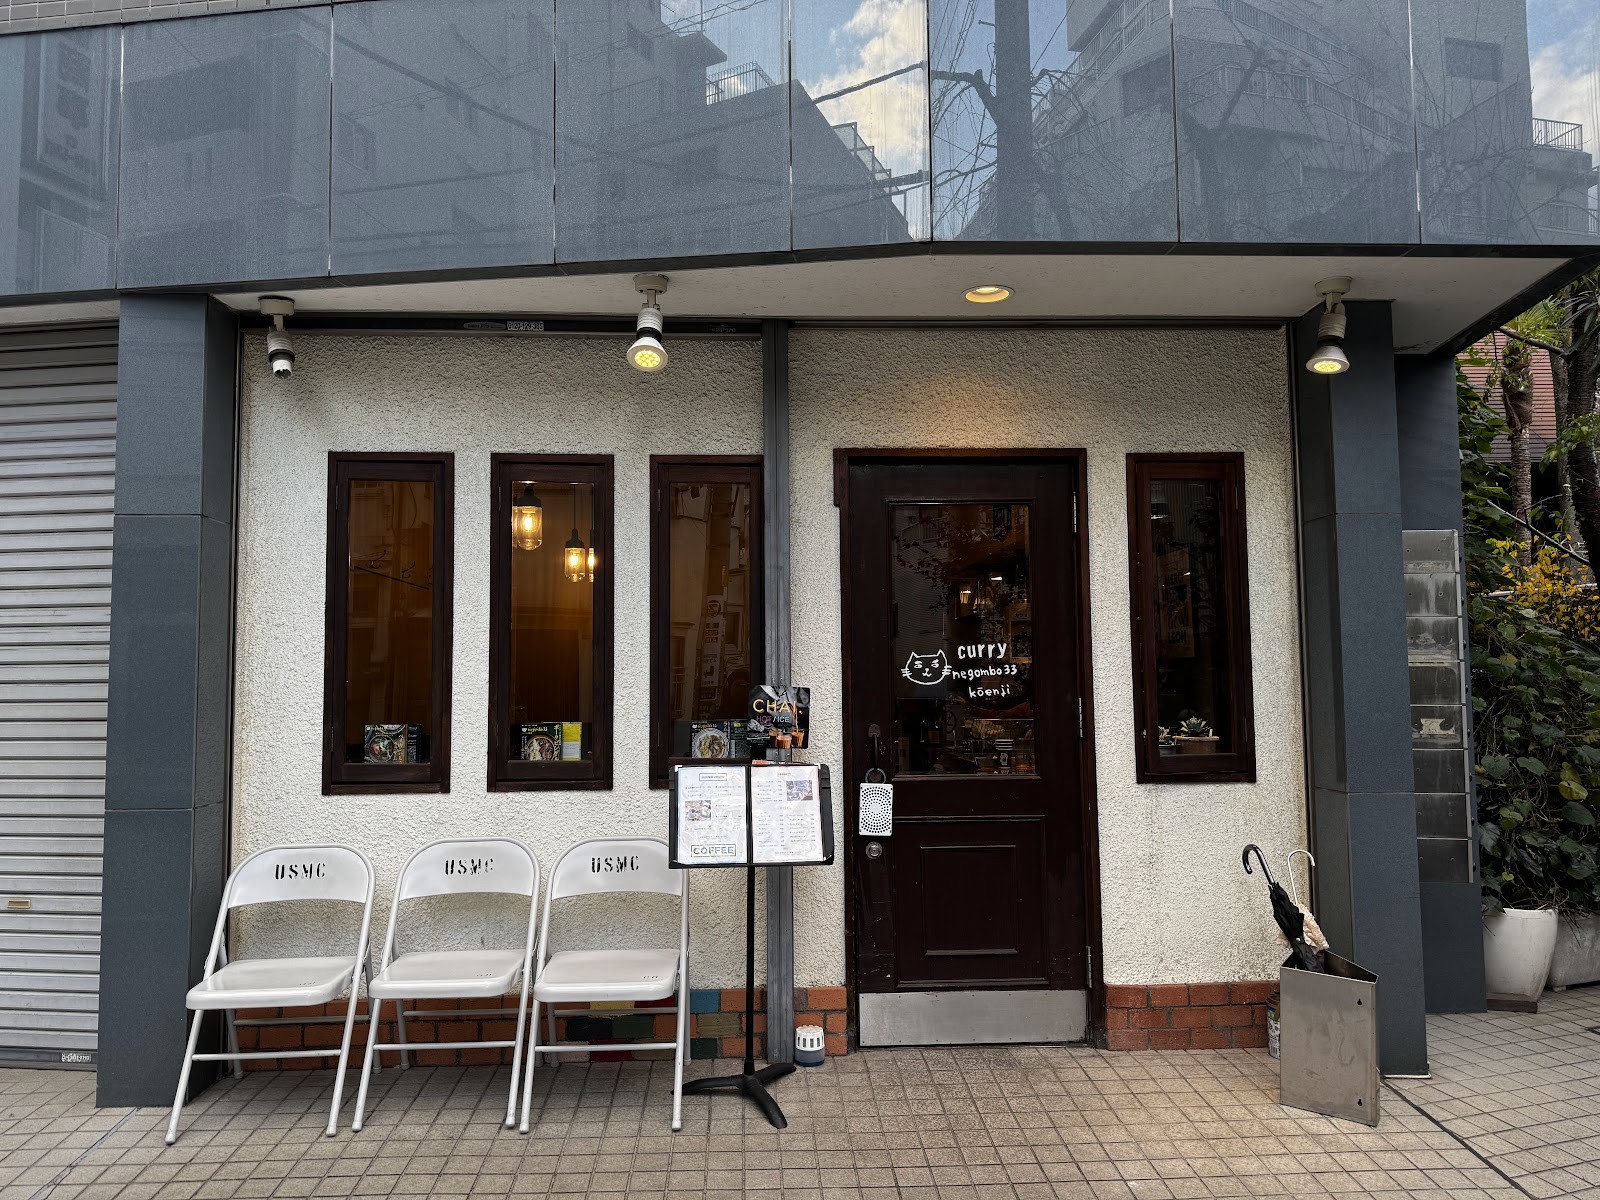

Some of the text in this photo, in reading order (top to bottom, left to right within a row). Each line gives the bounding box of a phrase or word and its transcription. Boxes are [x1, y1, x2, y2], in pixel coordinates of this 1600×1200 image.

[957, 642, 1007, 660] curry
[952, 664, 1018, 680] negombo33
[753, 699, 796, 714] CHAI
[693, 846, 734, 855] COFFEE
[275, 863, 325, 879] USMC
[445, 858, 493, 875] USMC
[591, 855, 639, 873] USMC
